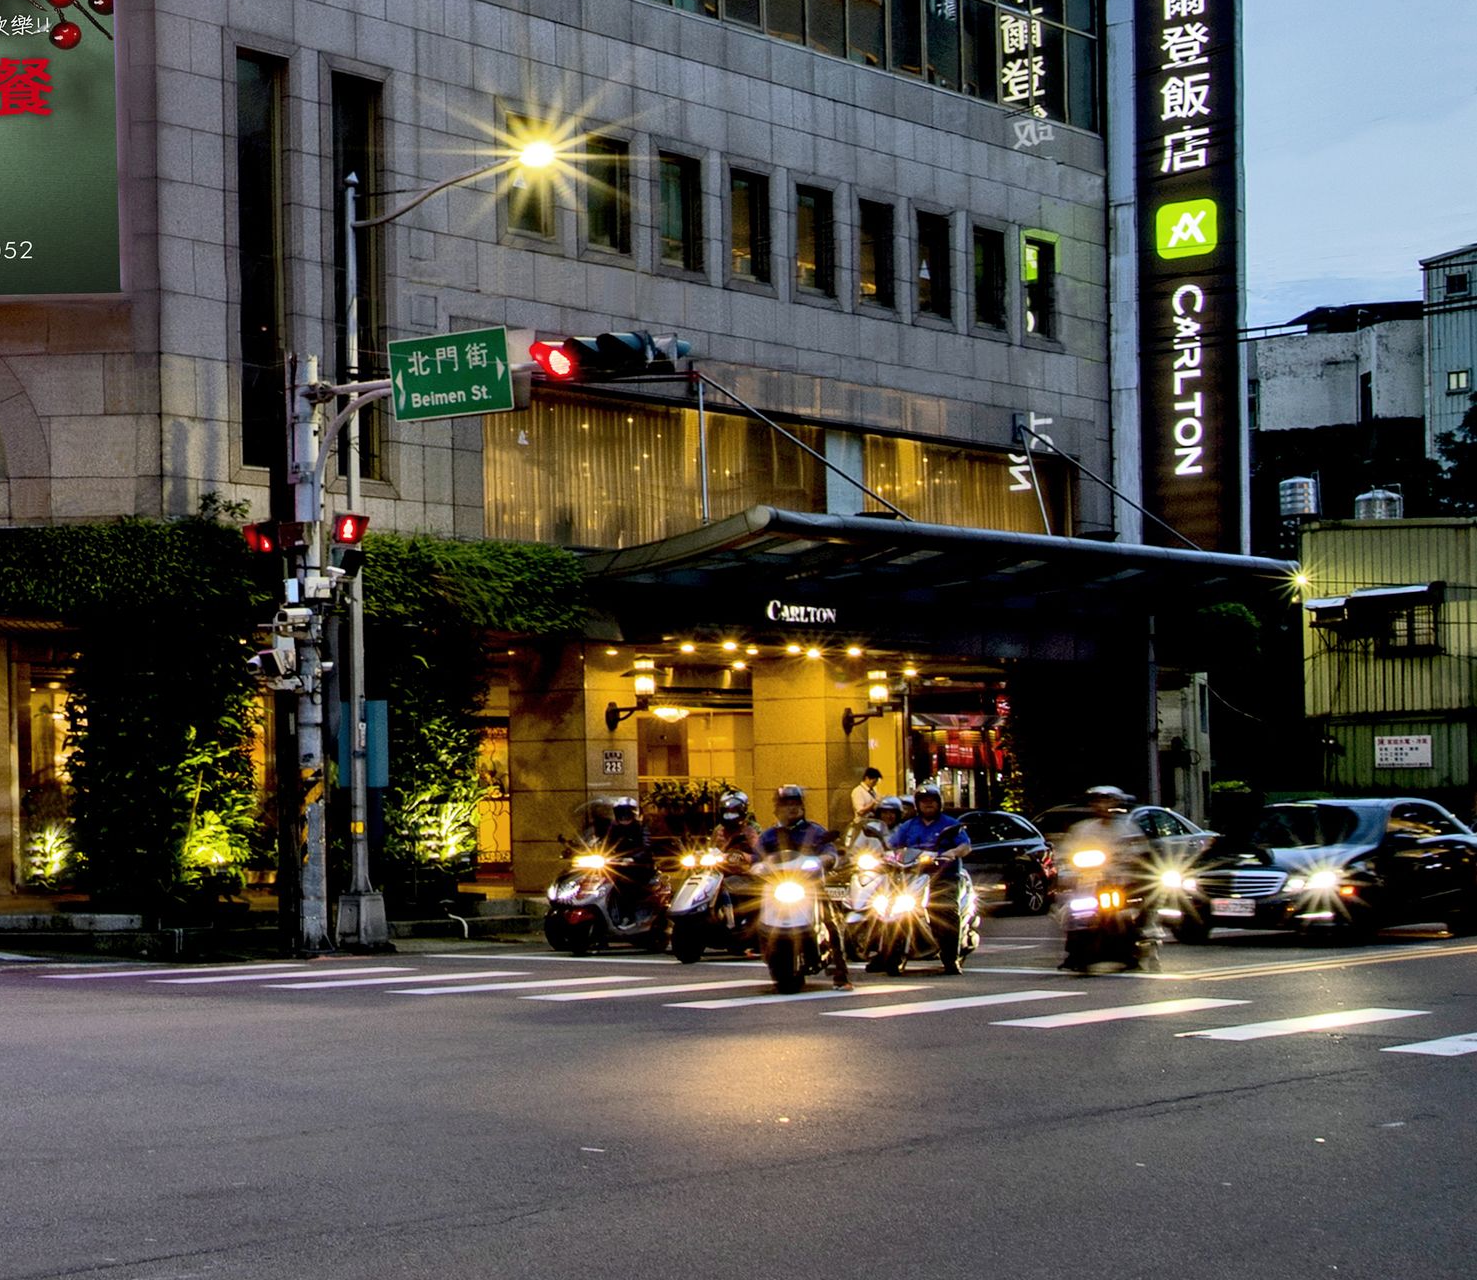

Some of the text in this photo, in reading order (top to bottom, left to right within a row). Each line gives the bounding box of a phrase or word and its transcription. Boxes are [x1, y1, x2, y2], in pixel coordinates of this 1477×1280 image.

[408, 343, 488, 376] 北門街
[1172, 283, 1204, 476] CARLTON
[411, 385, 492, 409] Beimen St.
